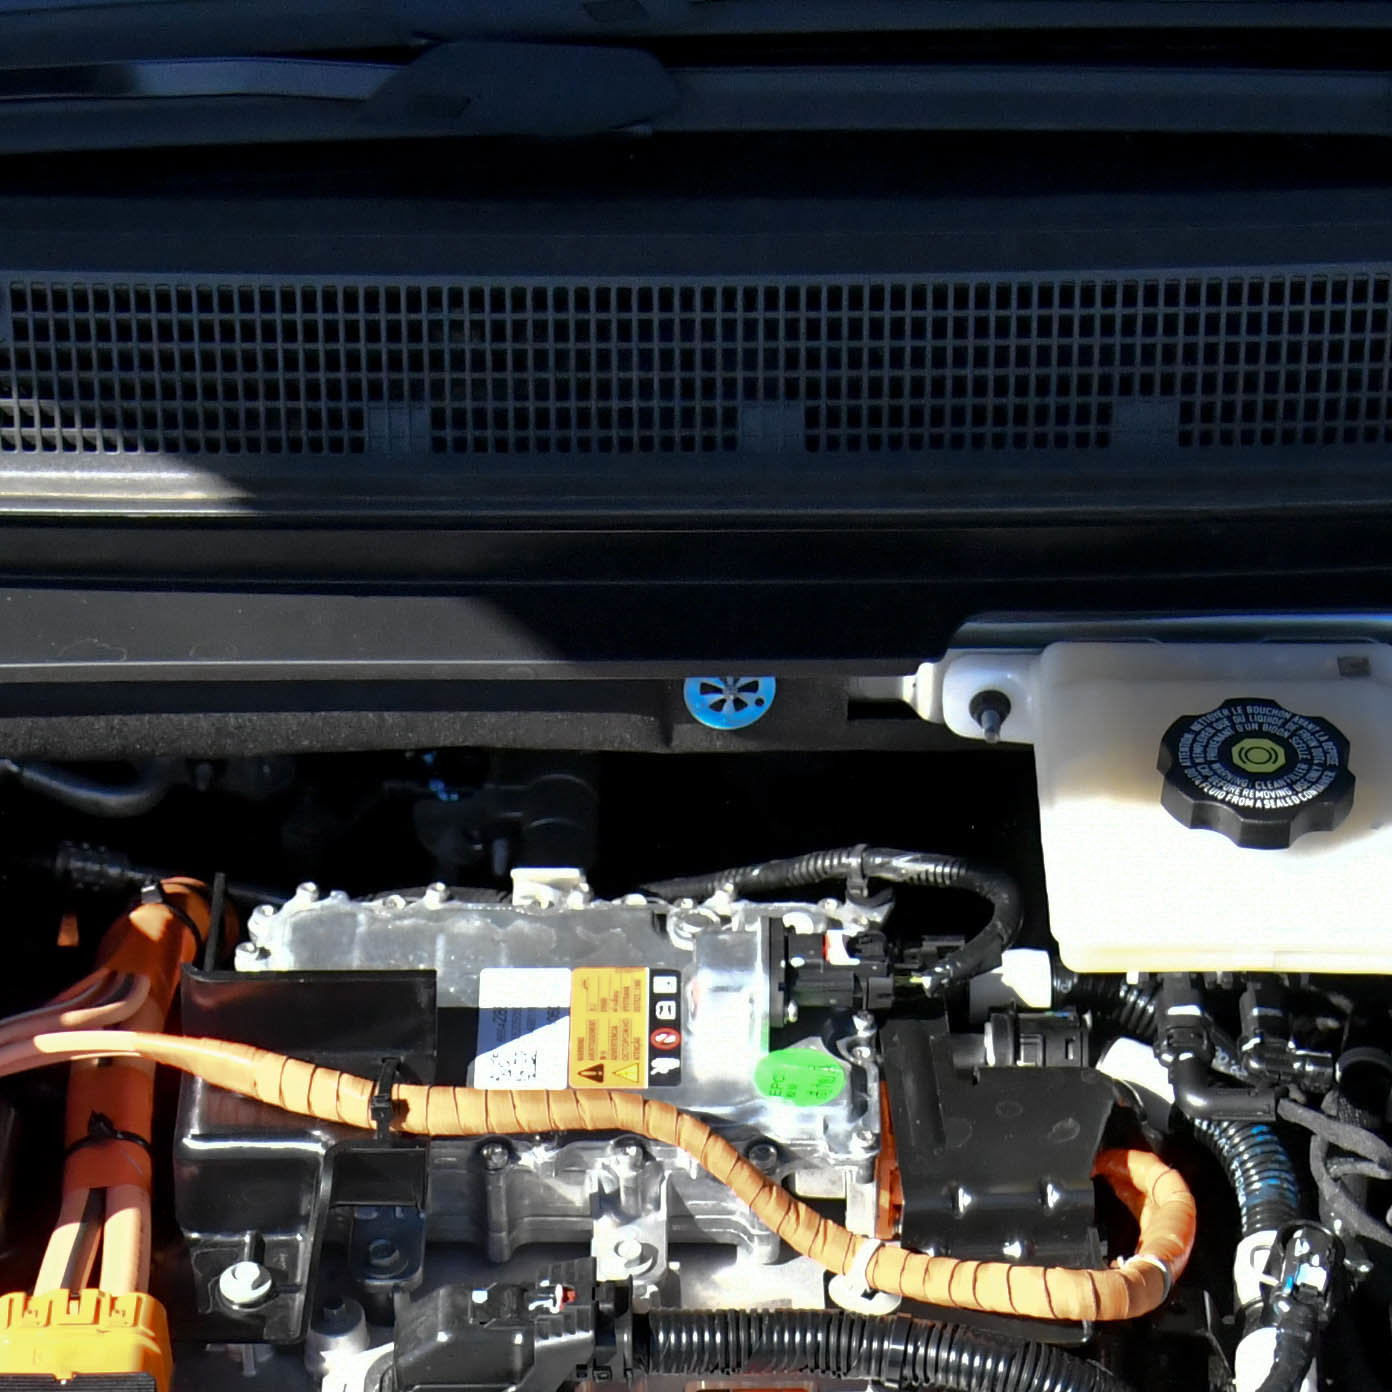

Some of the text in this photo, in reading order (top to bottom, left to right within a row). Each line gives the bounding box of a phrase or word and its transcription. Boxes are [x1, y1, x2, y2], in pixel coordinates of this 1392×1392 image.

[1231, 706, 1243, 714] LE
[1247, 706, 1292, 718] BOUCHON
[1315, 731, 1328, 742] LA
[1249, 715, 1283, 726] LIQUIDE
[1212, 774, 1241, 795] BEFORE
[1295, 779, 1312, 791] USE
[1255, 775, 1286, 790] CLEAN
[1199, 781, 1226, 799] FLUID
[1225, 794, 1255, 808] FROM
[1255, 800, 1262, 808] A
[1264, 795, 1301, 809] SEALED
